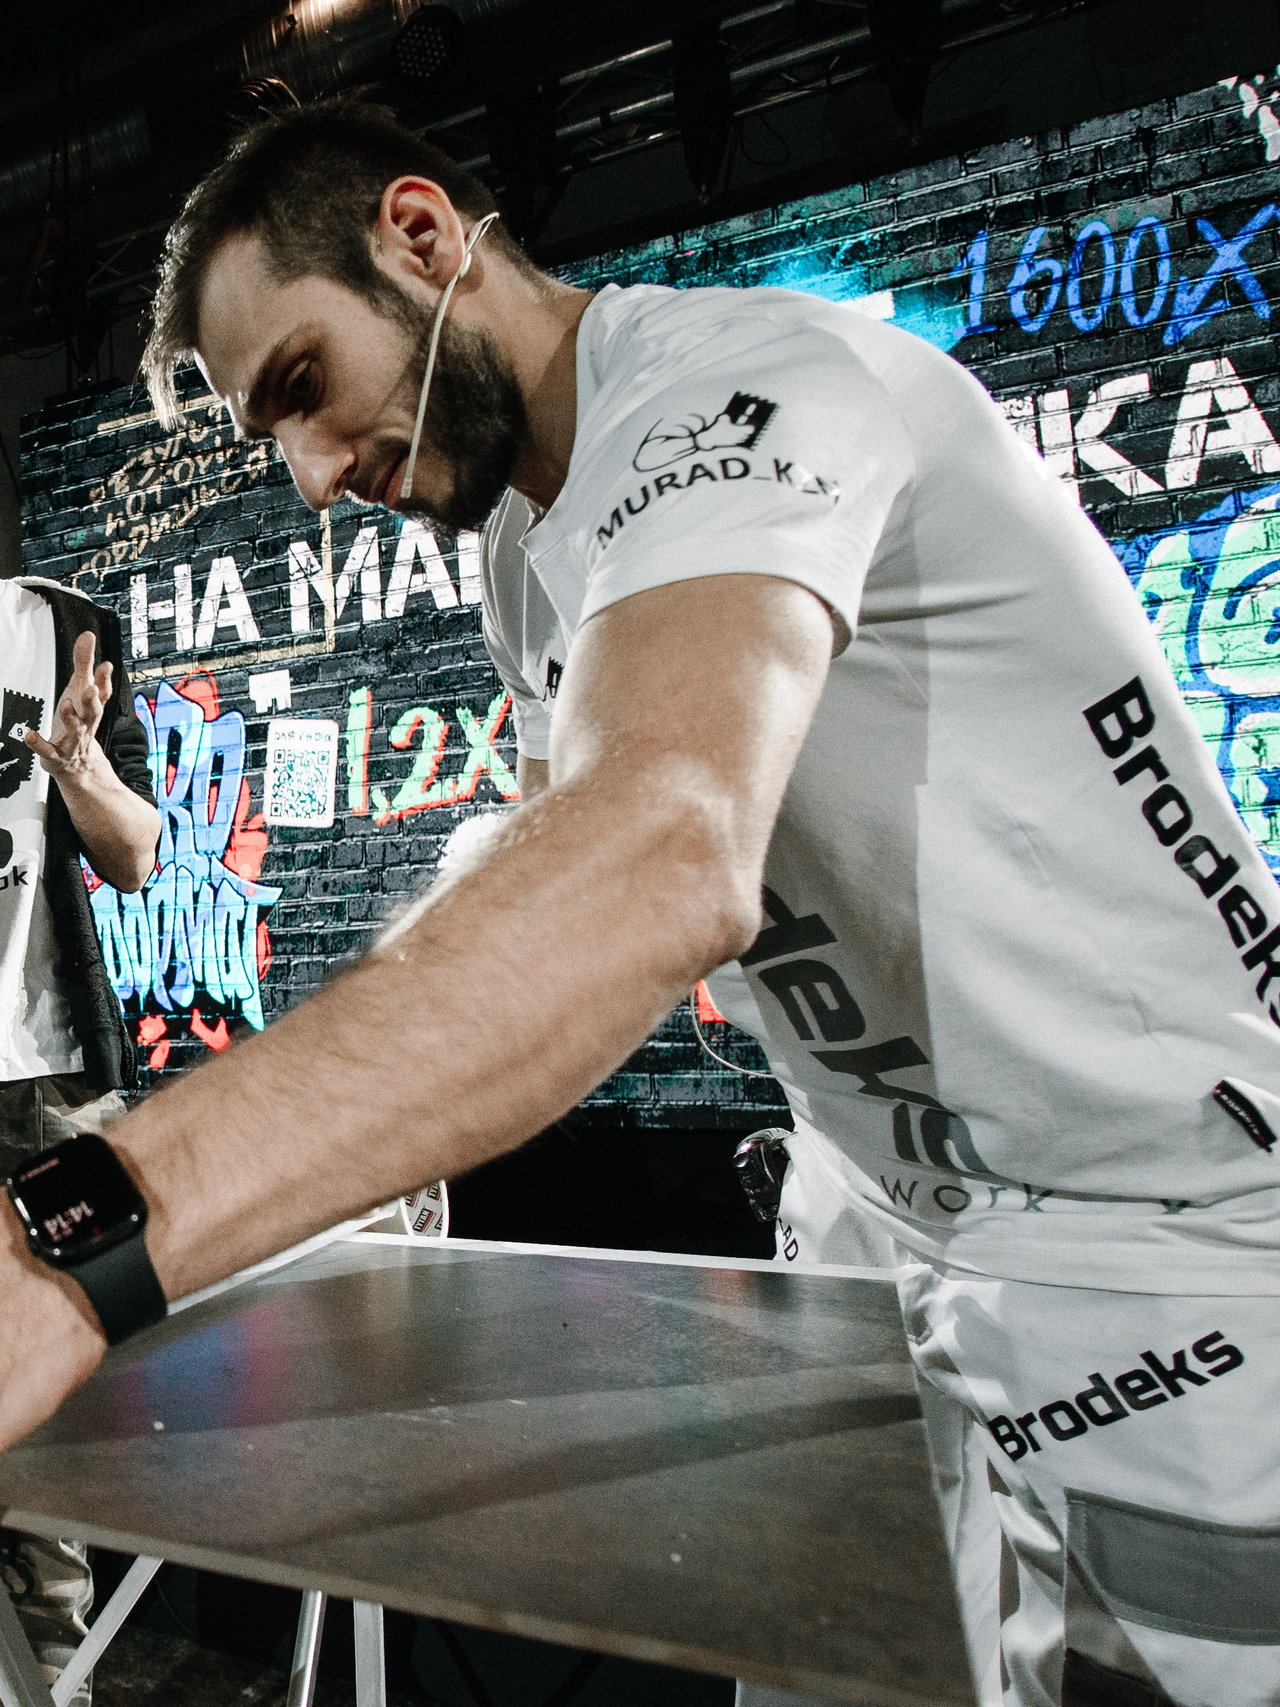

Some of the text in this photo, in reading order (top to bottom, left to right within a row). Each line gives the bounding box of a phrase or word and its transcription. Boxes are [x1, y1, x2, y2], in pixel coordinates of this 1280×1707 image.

[130, 555, 261, 658] НА
[992, 357, 1280, 500] КА
[1083, 675, 1280, 1026] Brodek
[986, 1330, 1244, 1462] Brodeks
